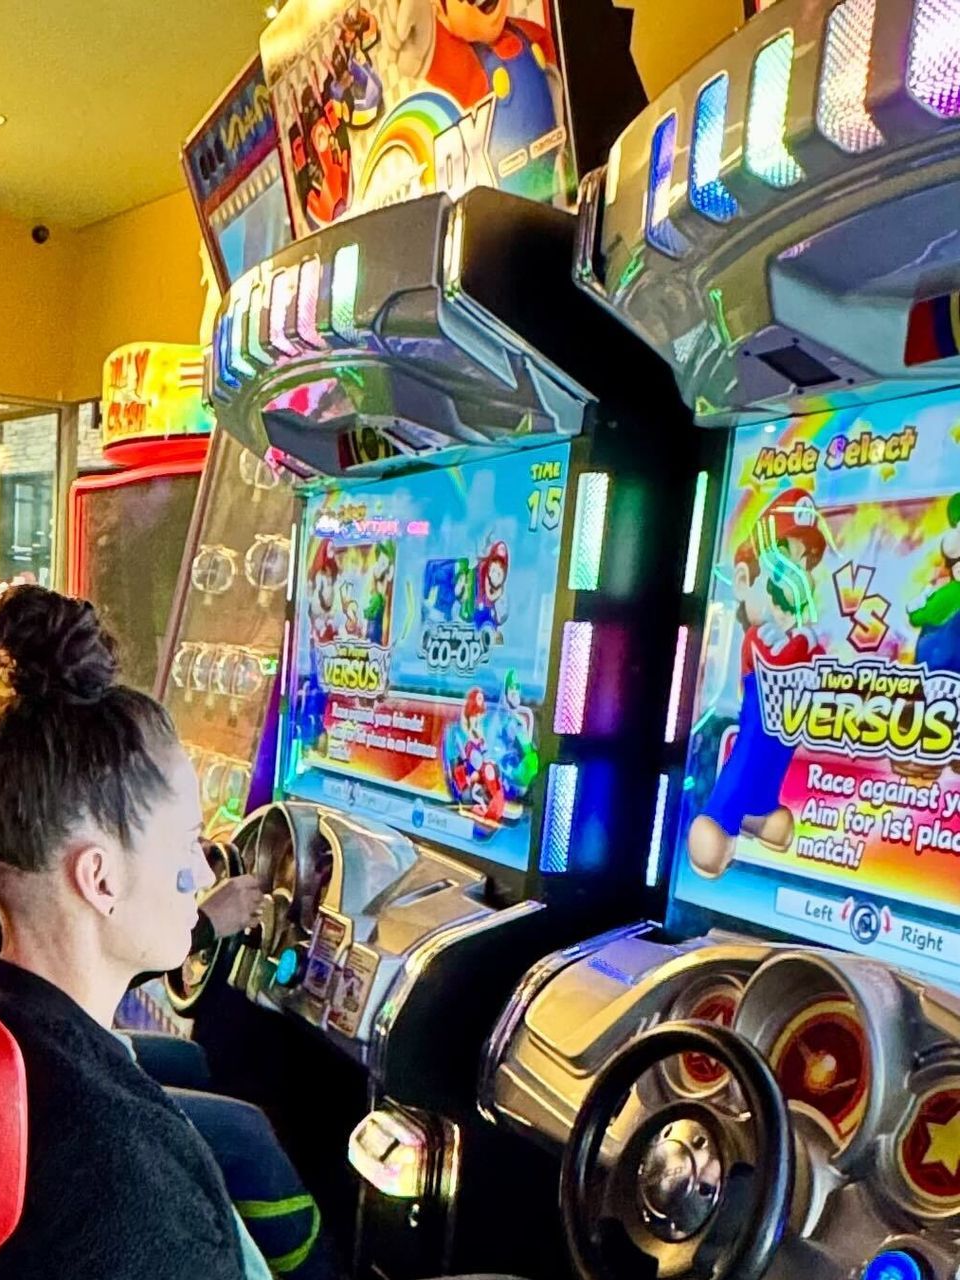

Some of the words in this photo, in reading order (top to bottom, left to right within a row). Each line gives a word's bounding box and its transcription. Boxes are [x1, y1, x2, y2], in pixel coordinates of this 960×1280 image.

[530, 461, 561, 481] TIME
[753, 441, 819, 479] Mode
[528, 486, 562, 532] 15
[832, 561, 892, 652] VS
[323, 656, 380, 691] VERSUS
[428, 642, 482, 670] CO-OP
[819, 665, 854, 690] Two
[857, 667, 920, 697] Player
[783, 688, 957, 751] VERSUS
[807, 763, 856, 795] Race
[858, 776, 940, 811] against
[800, 799, 838, 828] Aim
[844, 804, 874, 836] for
[881, 811, 913, 843] 1st
[796, 835, 864, 871] match!
[804, 900, 833, 922] Left
[901, 926, 943, 951] Right
